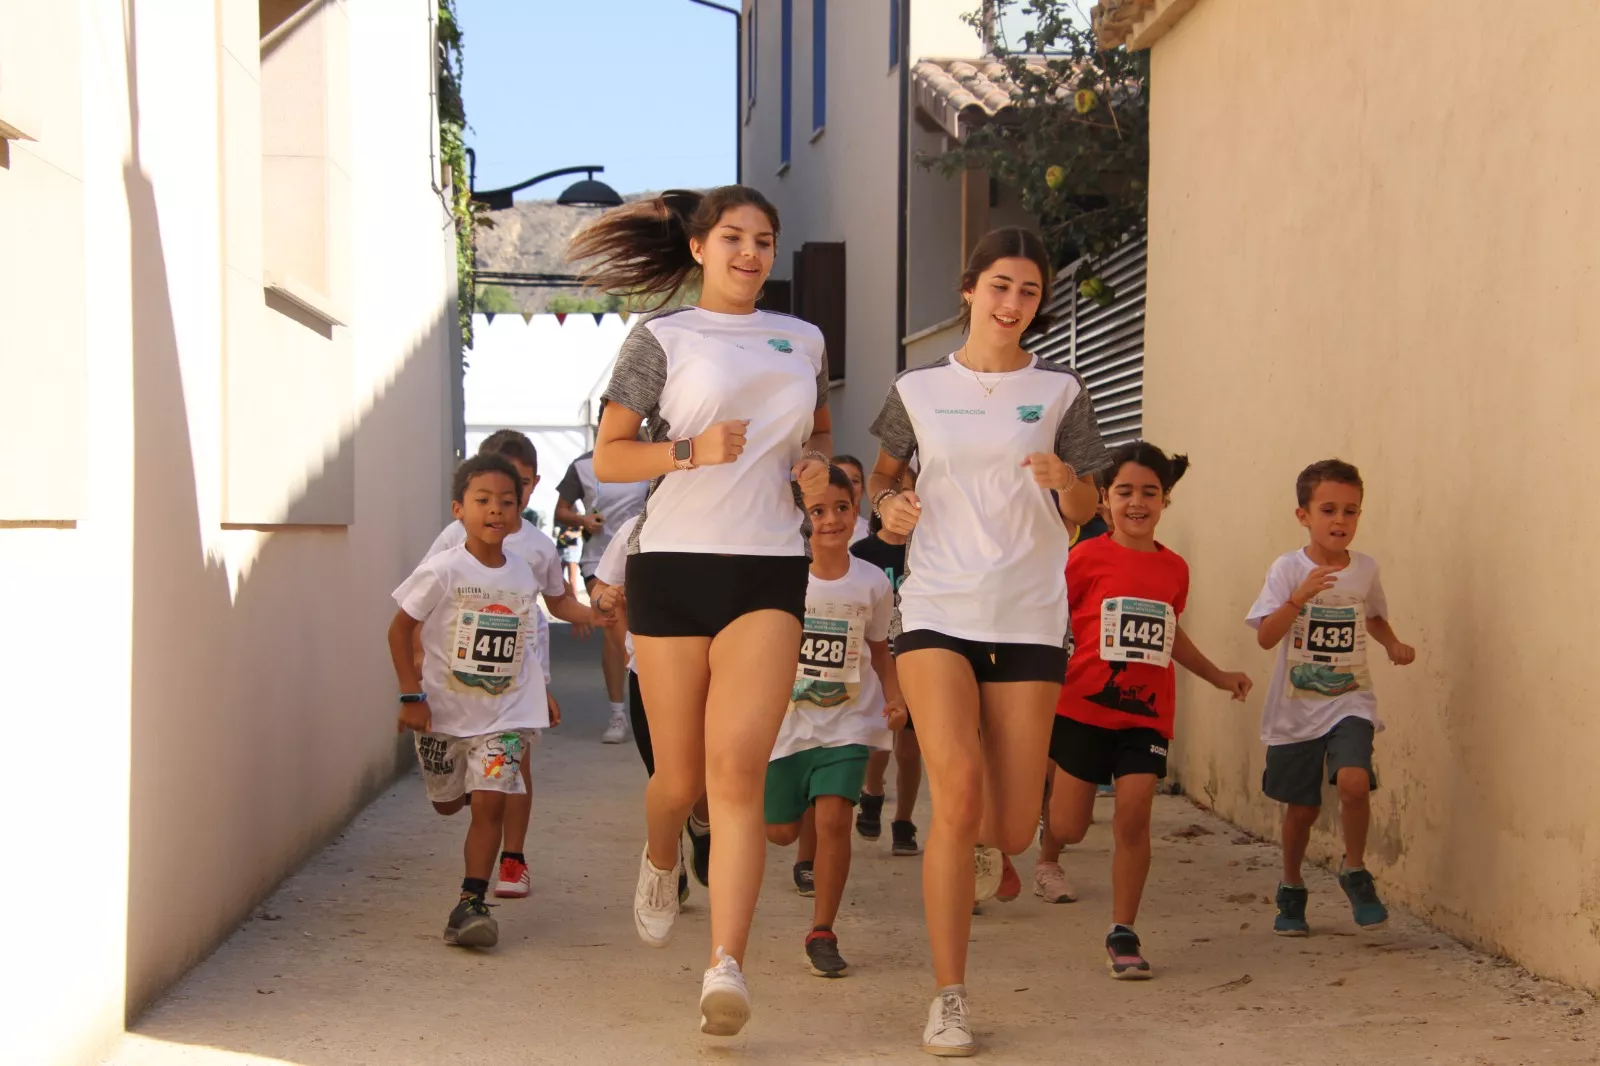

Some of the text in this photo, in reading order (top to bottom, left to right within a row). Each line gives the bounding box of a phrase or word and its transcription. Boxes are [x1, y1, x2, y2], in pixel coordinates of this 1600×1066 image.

[1122, 620, 1164, 646] 442
[1310, 626, 1353, 648] 433
[475, 634, 515, 658] 416
[800, 638, 845, 663] 428
